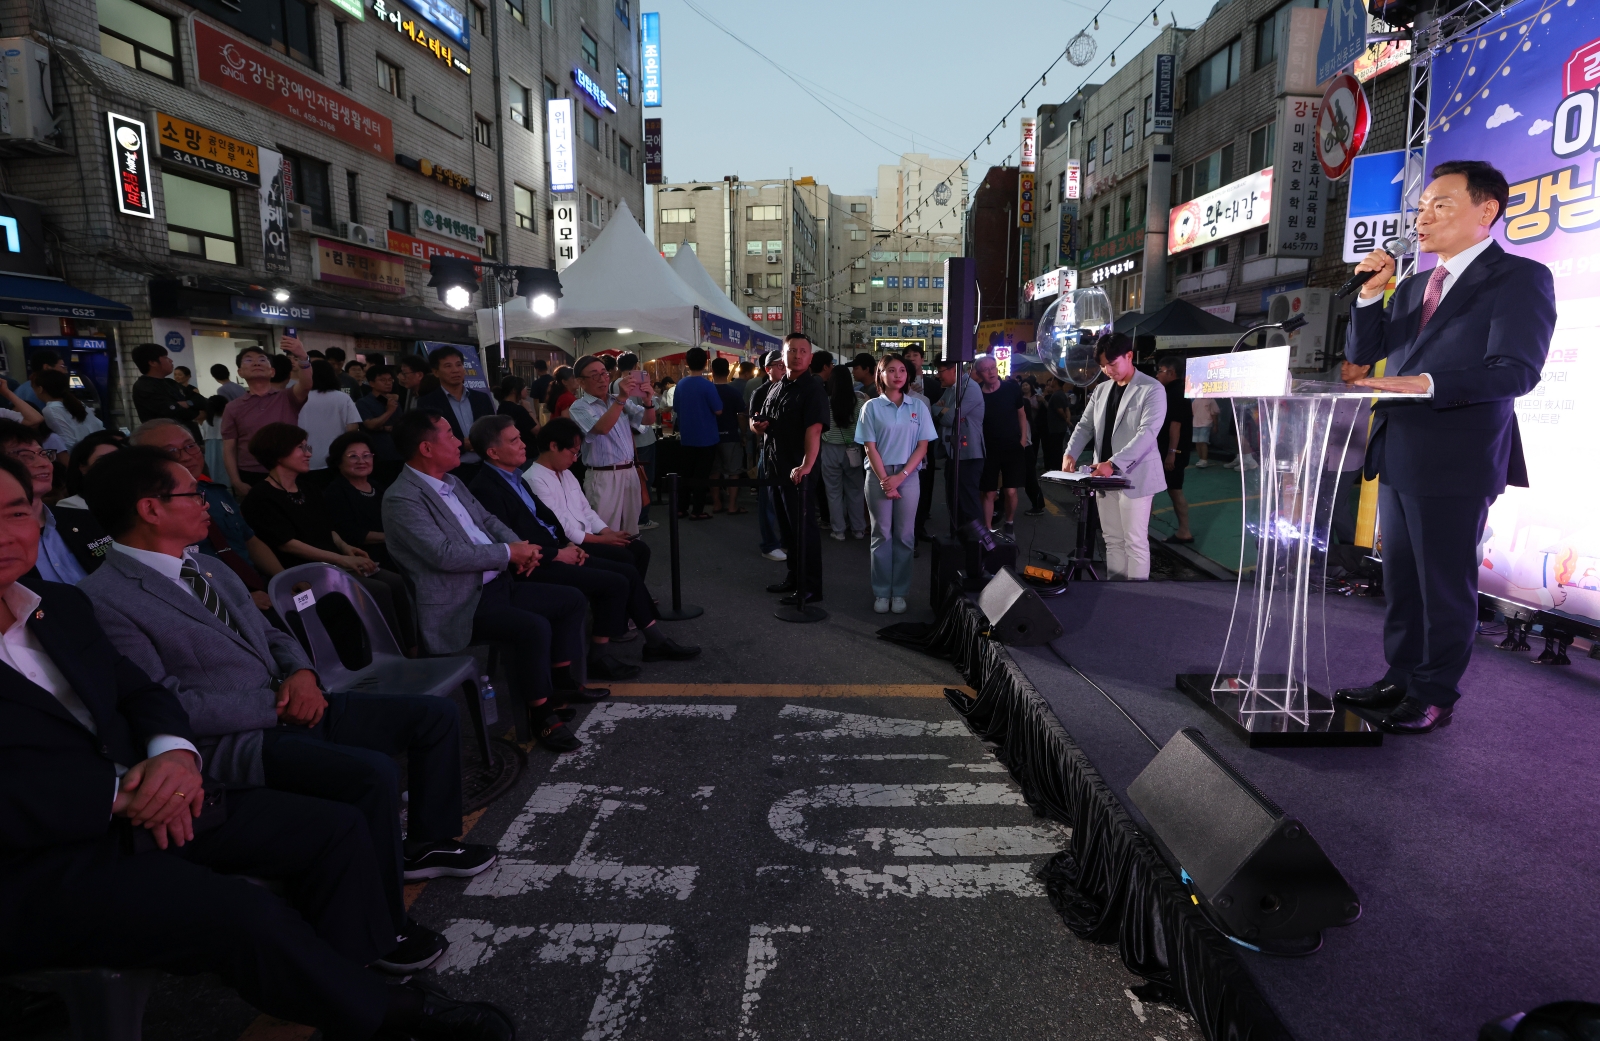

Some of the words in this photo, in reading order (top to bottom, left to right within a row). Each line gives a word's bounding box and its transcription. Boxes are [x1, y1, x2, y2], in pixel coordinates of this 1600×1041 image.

[1318, 37, 1362, 81] 보행자전용도로
[249, 60, 381, 138] 강남장애인자립생활센터
[162, 120, 202, 151] 소망
[207, 135, 255, 159] 공인중개사
[646, 134, 662, 148] 국어
[173, 150, 249, 182] 3411-8383
[1287, 123, 1305, 229] 미래간호학원
[1305, 125, 1321, 229] 보호사교육원
[1068, 171, 1078, 198] 족발
[1203, 191, 1259, 238] 왕대감
[557, 207, 574, 260] 이모네
[1282, 242, 1319, 251] 445-7773
[332, 250, 369, 271] 컴퓨터
[72, 307, 95, 317] GS25
[260, 301, 289, 317] 오피스
[44, 339, 59, 347] ATM
[83, 339, 105, 349] ATM
[168, 337, 181, 346] ADT
[1206, 368, 1219, 380] 야식
